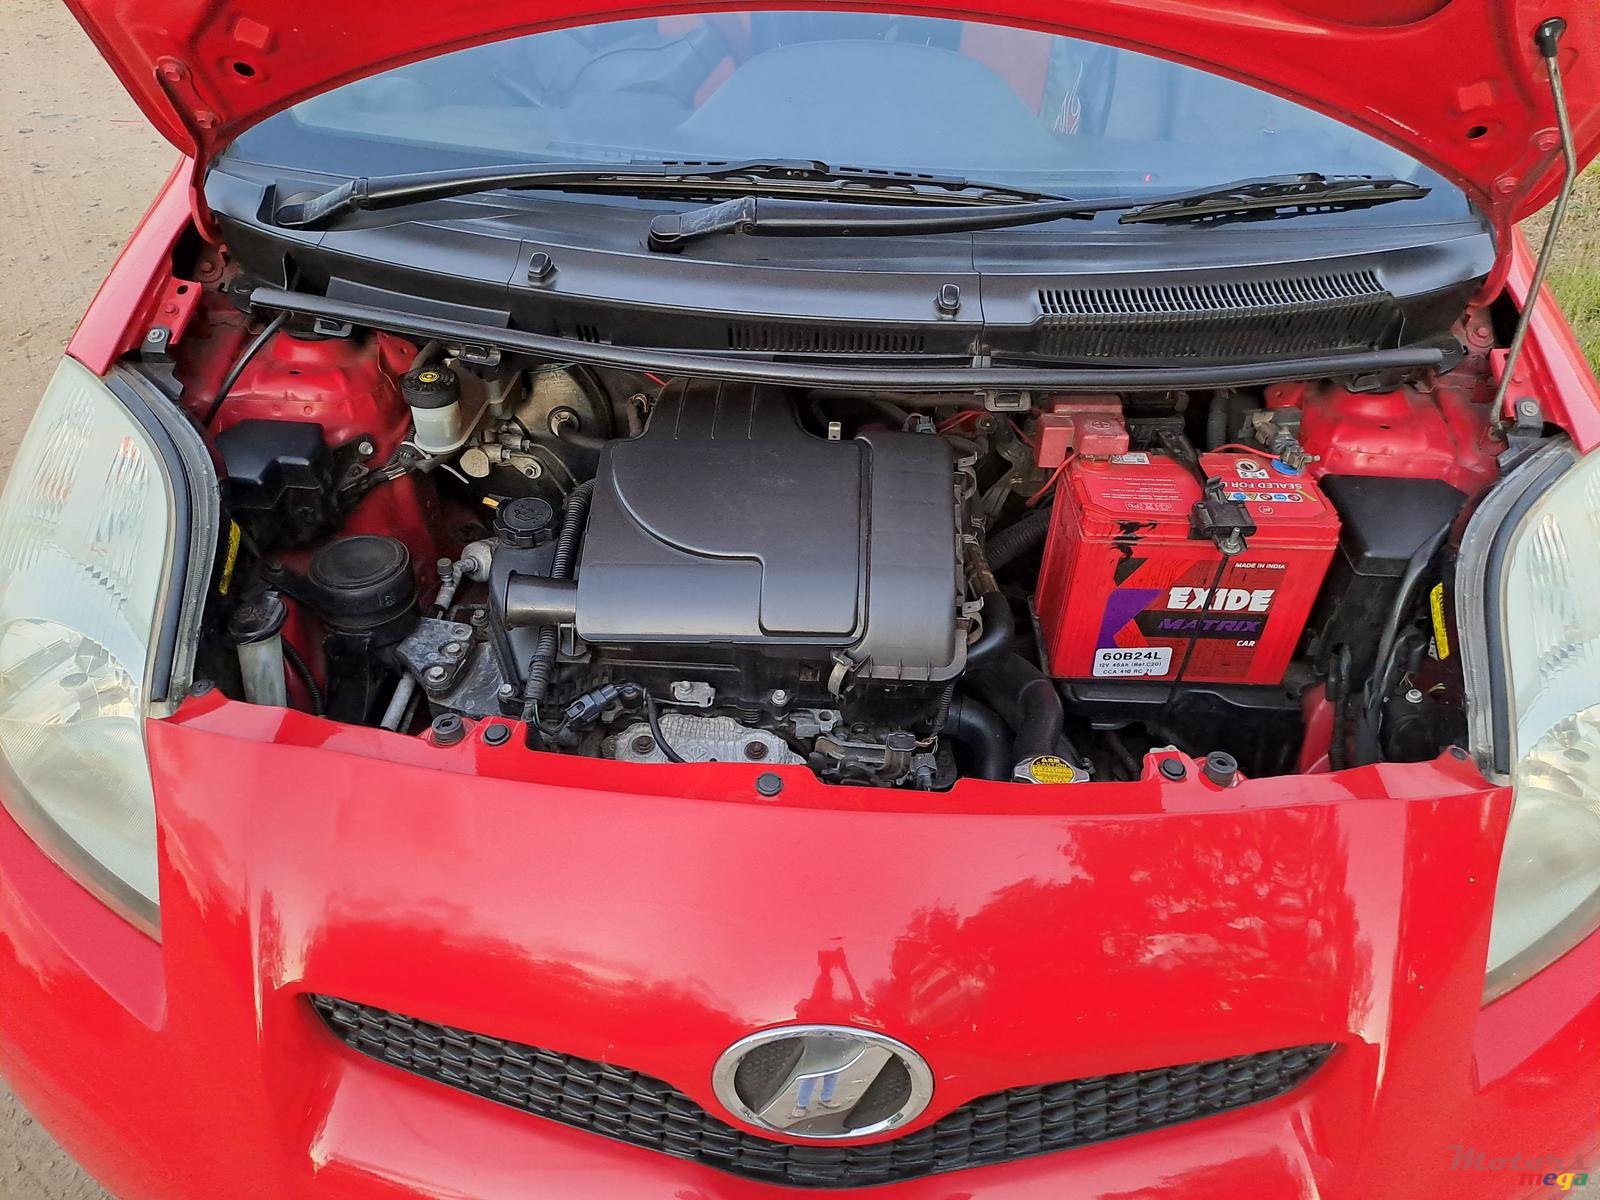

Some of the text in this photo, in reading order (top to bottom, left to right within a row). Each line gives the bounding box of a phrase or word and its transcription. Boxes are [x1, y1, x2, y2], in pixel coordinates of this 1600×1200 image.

[1258, 482, 1303, 490] SEALED
[1167, 586, 1275, 612] EXIDE
[1158, 618, 1261, 632] MATRIX
[1102, 651, 1162, 661] 60B24L
